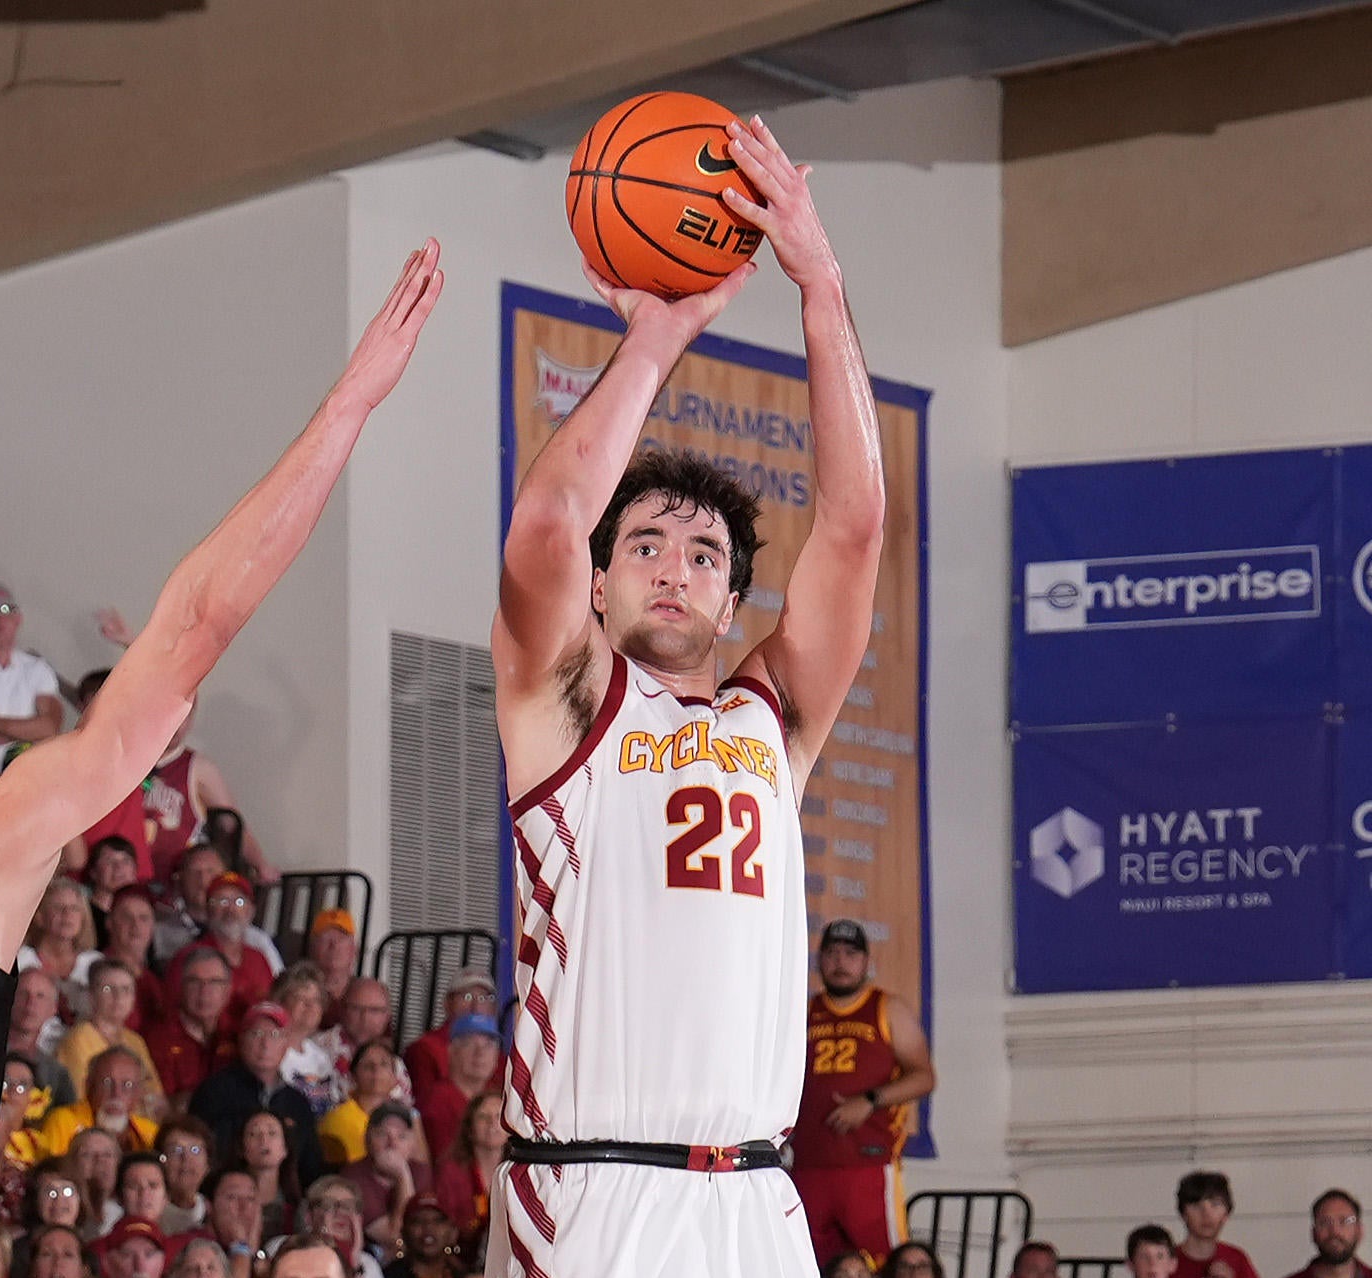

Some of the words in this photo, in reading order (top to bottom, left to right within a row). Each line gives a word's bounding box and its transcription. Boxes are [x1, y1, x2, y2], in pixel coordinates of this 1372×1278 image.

[674, 204, 761, 255] ELITE
[1030, 562, 1313, 614] enterprise
[618, 721, 779, 797] CYCLNE
[665, 785, 766, 899] 22
[1119, 807, 1263, 848] HYATT
[1119, 845, 1312, 886] REGENCY
[814, 1037, 858, 1074] 22
